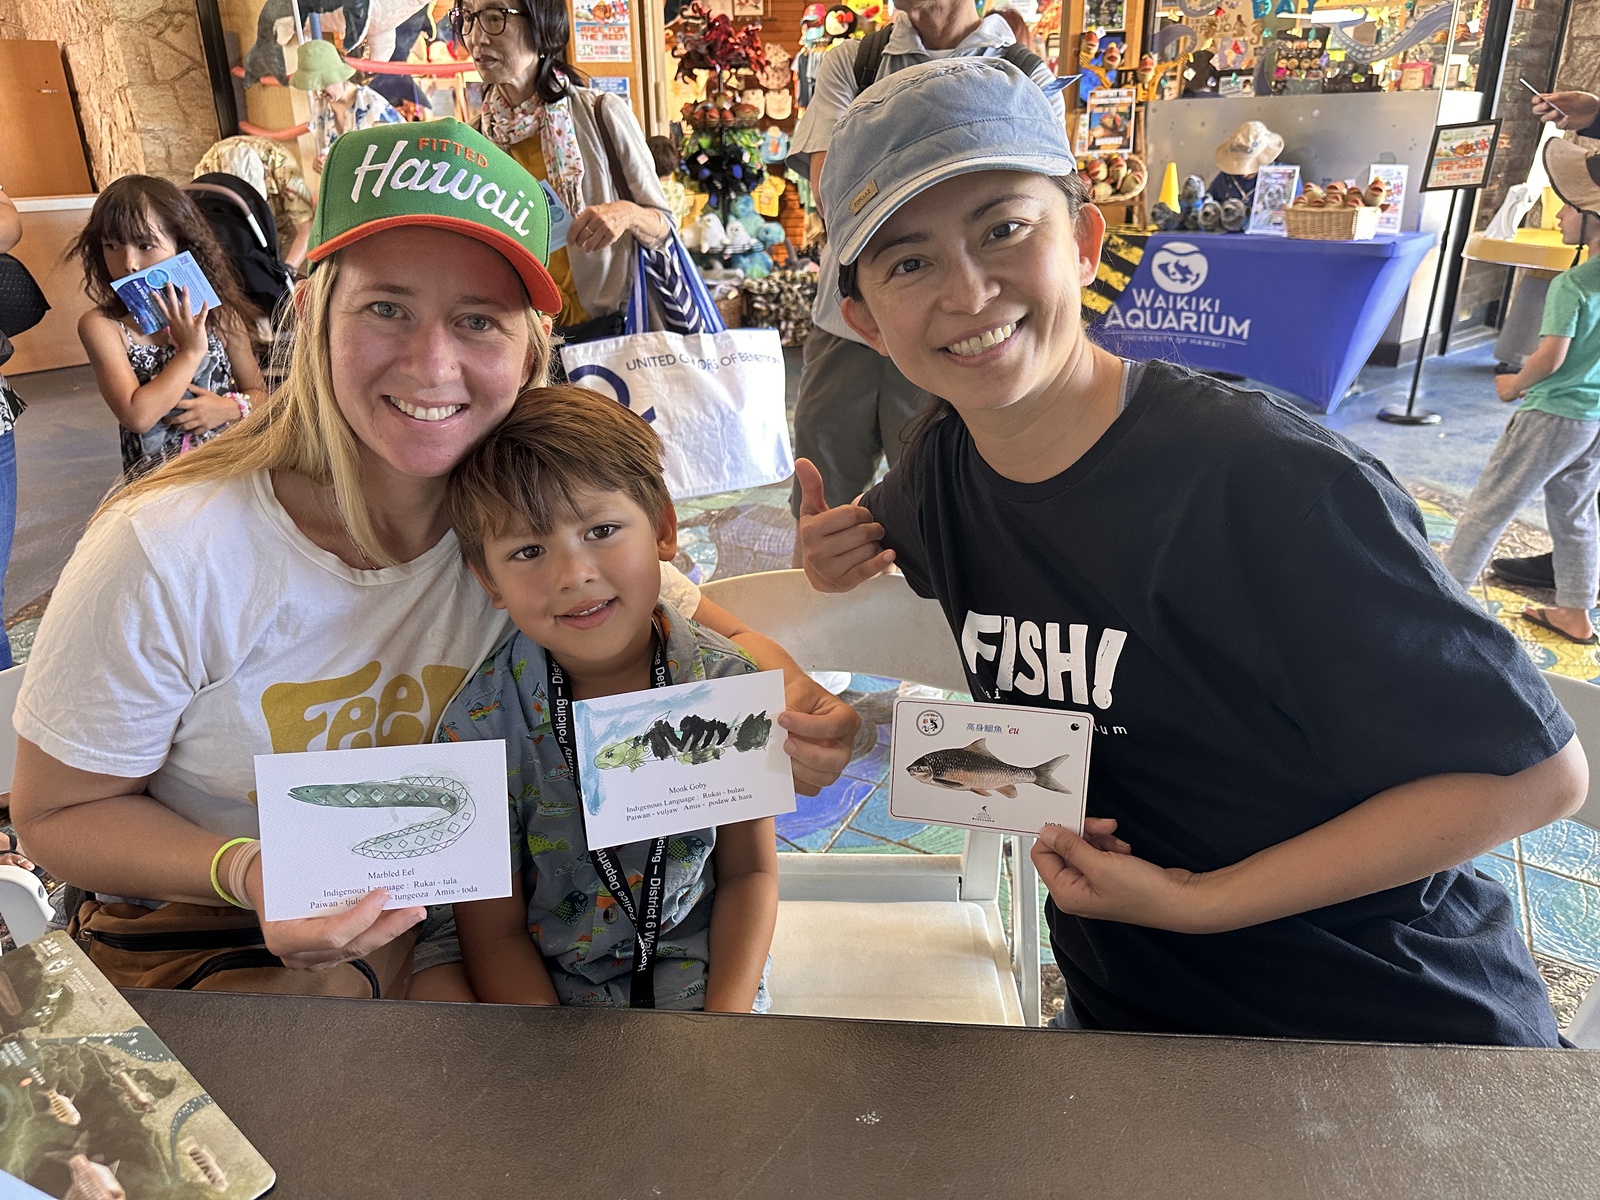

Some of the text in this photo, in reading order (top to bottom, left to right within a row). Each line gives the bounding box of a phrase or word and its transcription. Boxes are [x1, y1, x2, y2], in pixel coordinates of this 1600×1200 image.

[580, 33, 598, 41] THE
[418, 137, 488, 168] FITTED
[350, 140, 535, 237] Hawaii
[1132, 288, 1220, 313] WAIKIKI
[1103, 303, 1251, 340] AQUARIUM
[1174, 336, 1188, 344] OF
[626, 354, 677, 371] UNITED
[720, 353, 738, 367] OF
[961, 609, 1128, 710] FISH!
[555, 699, 569, 744] Policing
[626, 802, 663, 813] Indigenous
[664, 795, 696, 806] Language
[702, 790, 722, 799] Rukai
[727, 786, 745, 795] bulau
[668, 782, 708, 795] Monk Goby
[626, 812, 651, 821] Paiwan
[683, 803, 701, 811] Amis
[708, 797, 730, 808] podaw
[368, 868, 415, 880] Marbled Eel
[310, 901, 338, 910] Paiwan
[434, 888, 455, 897] Amis
[462, 886, 478, 894] toda
[323, 887, 366, 898] Indigenous
[413, 879, 436, 888] Rukai
[443, 878, 457, 886] tula
[646, 878, 662, 919] District
[617, 890, 637, 920] Police
[645, 921, 657, 929] 6
